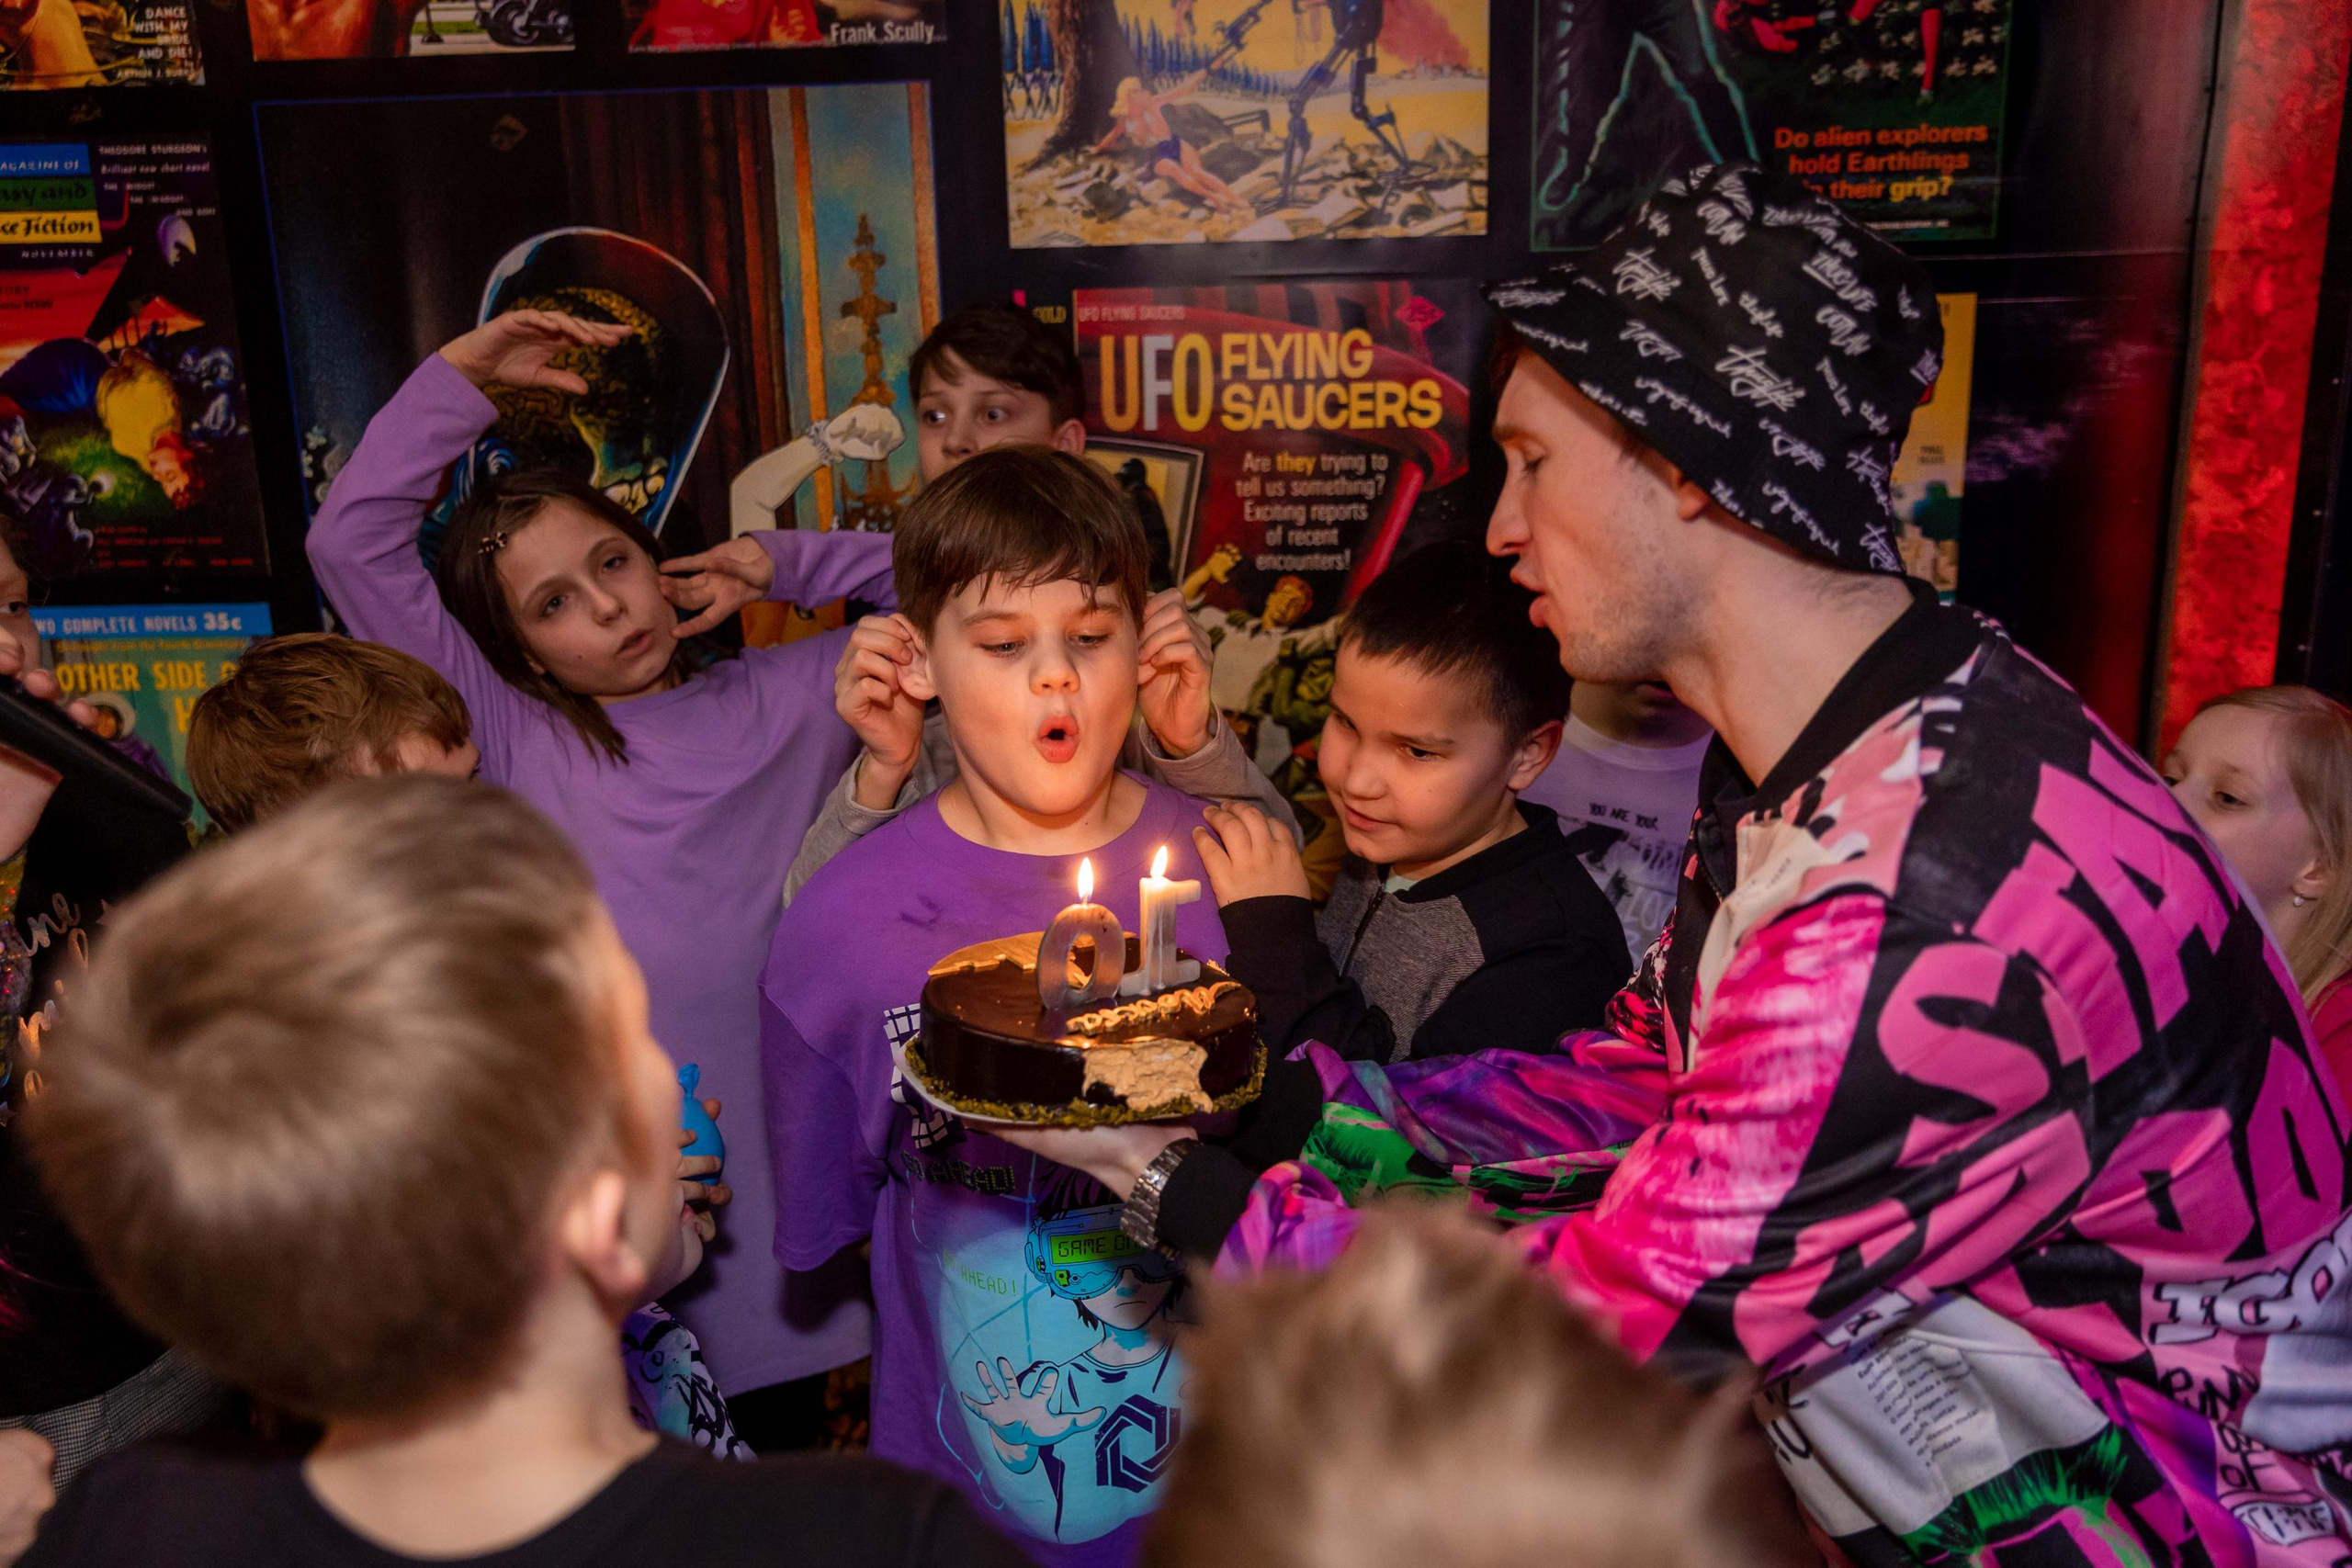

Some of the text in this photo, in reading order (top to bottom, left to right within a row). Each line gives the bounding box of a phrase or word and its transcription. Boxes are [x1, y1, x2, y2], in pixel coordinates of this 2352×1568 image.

[145, 6, 187, 19] DANCE
[134, 19, 188, 33] WITH MY
[830, 20, 934, 45] Frank Scully
[138, 48, 164, 60] AND
[1774, 122, 1988, 149] Do alien explorers
[1789, 150, 1970, 175] hold Earthlings
[1828, 177, 1885, 199] their
[1889, 175, 1954, 203] grip?
[24, 218, 93, 236] Fiction
[21, 249, 94, 259] NOVEMBER
[1220, 328, 1374, 381] FLYING
[1100, 333, 1214, 433] UFO
[1220, 378, 1443, 432] SAUCERS
[1242, 450, 1389, 477] Are they trying to
[1235, 473, 1386, 500] tell us something?
[1243, 499, 1369, 526] Exciting reports
[1265, 524, 1340, 547] of recent
[1255, 547, 1351, 570] encounters!
[62, 615, 137, 636] COMPLETE
[143, 615, 198, 632] NOVELS
[56, 661, 140, 694] OTHER
[152, 661, 208, 691] SIDE
[1058, 1236, 1106, 1258] GAME
[961, 1265, 1016, 1297] AHEAD!
